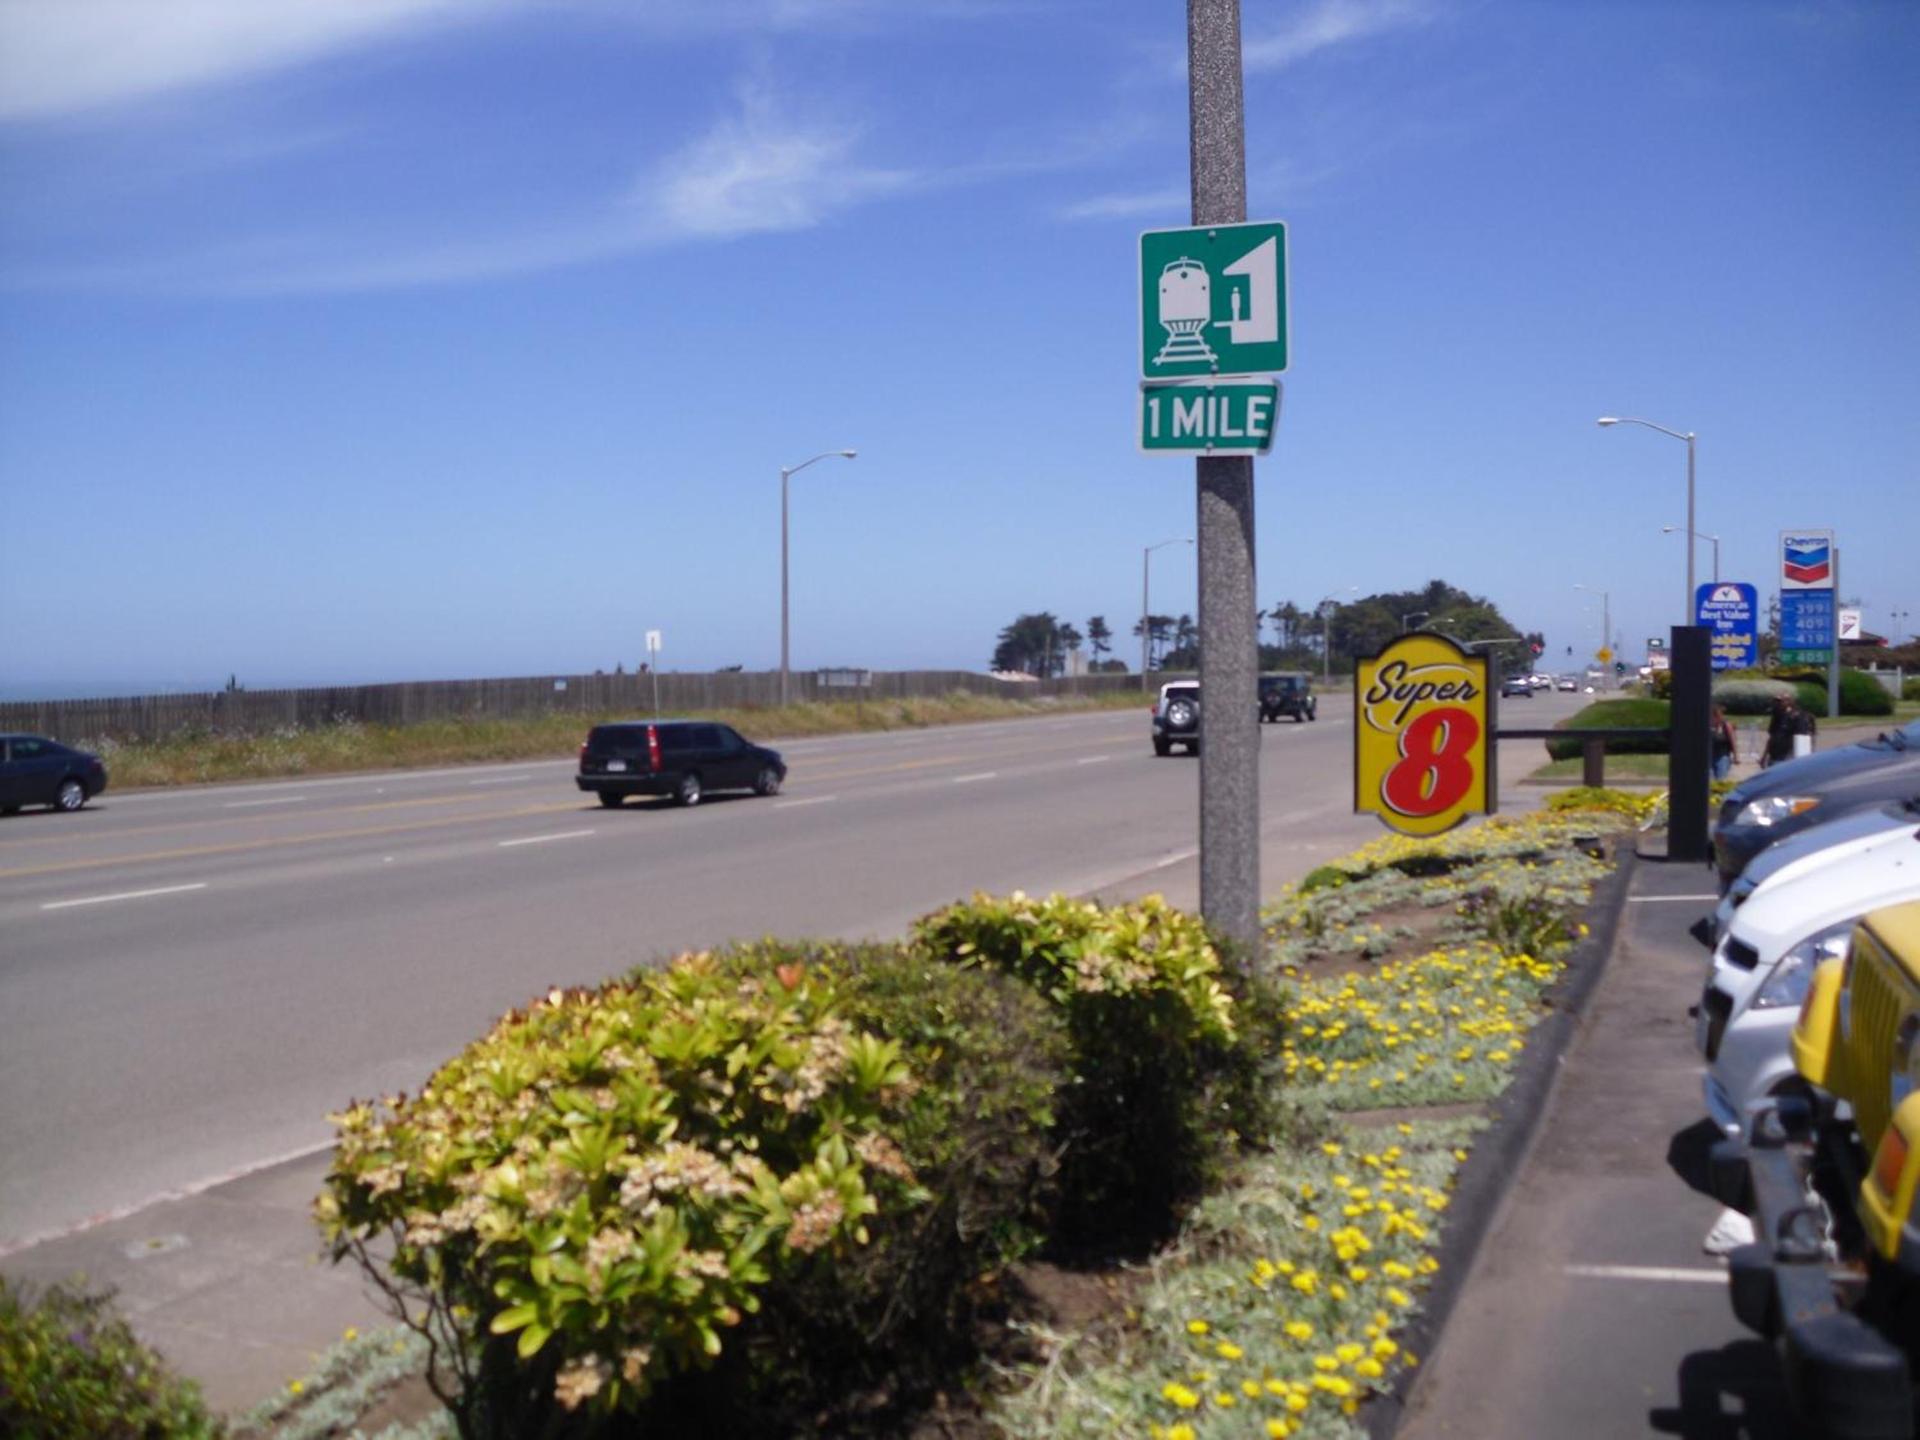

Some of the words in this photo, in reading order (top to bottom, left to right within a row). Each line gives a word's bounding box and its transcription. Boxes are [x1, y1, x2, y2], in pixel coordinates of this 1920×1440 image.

[1148, 397, 1160, 438] 1
[1172, 396, 1272, 437] MILE
[1783, 537, 1829, 546] Chevron
[1366, 661, 1480, 725] Super
[1380, 707, 1480, 818] 8
